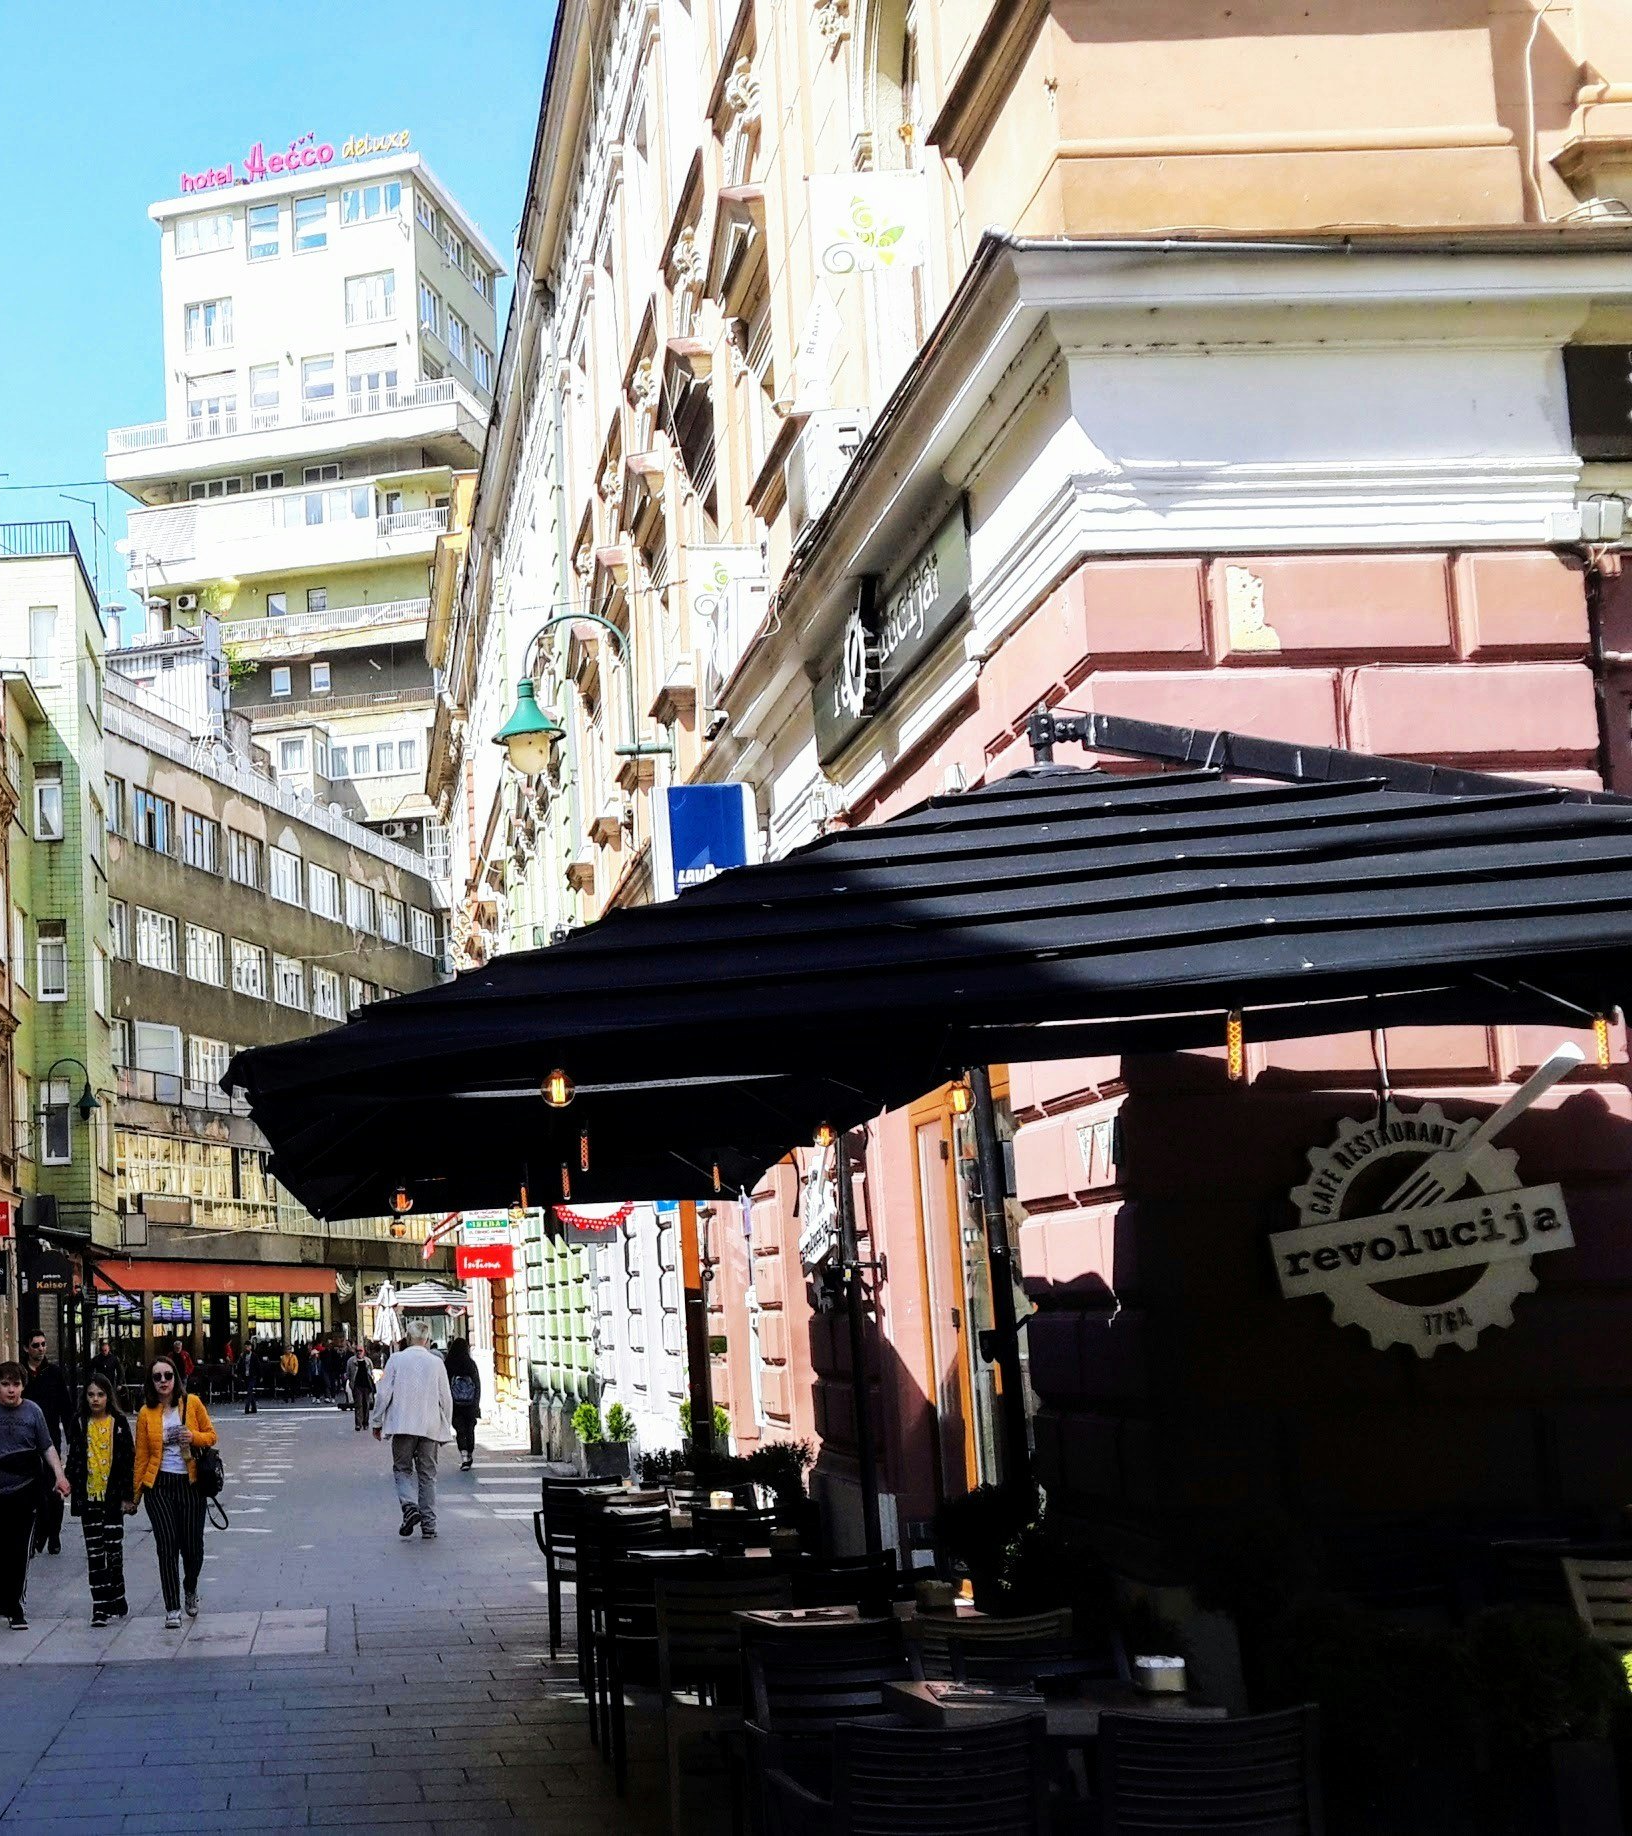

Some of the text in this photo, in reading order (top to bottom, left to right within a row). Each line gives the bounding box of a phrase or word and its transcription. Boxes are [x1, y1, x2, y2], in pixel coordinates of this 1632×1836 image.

[180, 163, 233, 192] hotel
[341, 128, 411, 160] deluxe
[677, 863, 741, 884] LAVA
[1310, 1120, 1458, 1216] CAFE RESTAURANT
[1285, 1202, 1562, 1278] revolucija
[36, 1280, 68, 1290] Kaiser
